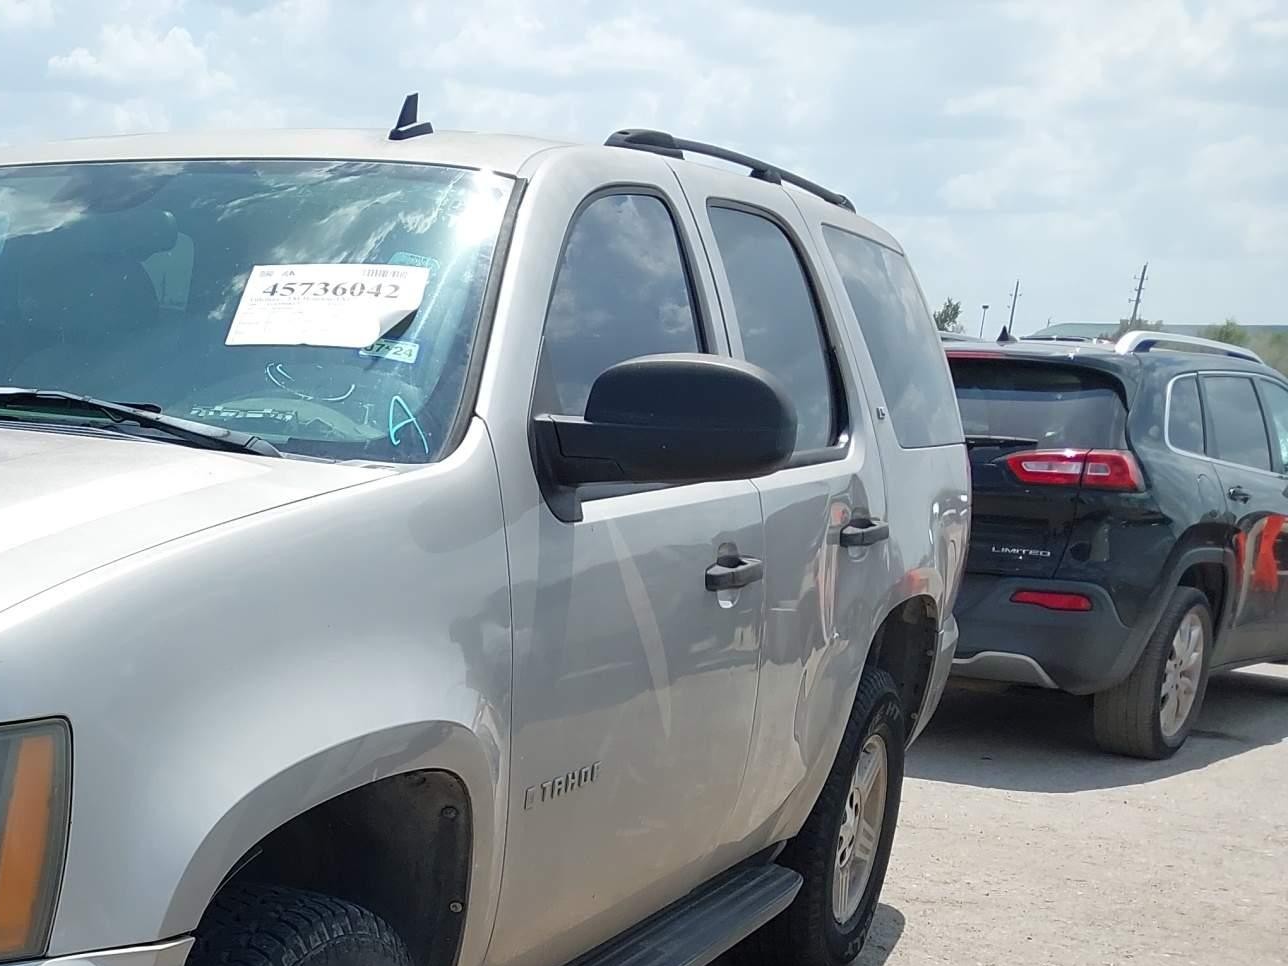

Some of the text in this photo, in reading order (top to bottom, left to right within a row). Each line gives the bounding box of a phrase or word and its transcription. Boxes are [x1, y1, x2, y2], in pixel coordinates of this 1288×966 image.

[262, 281, 401, 299] 45736042
[389, 395, 429, 454] A
[991, 546, 1051, 557] LIMITED
[540, 760, 602, 803] TAHOE
